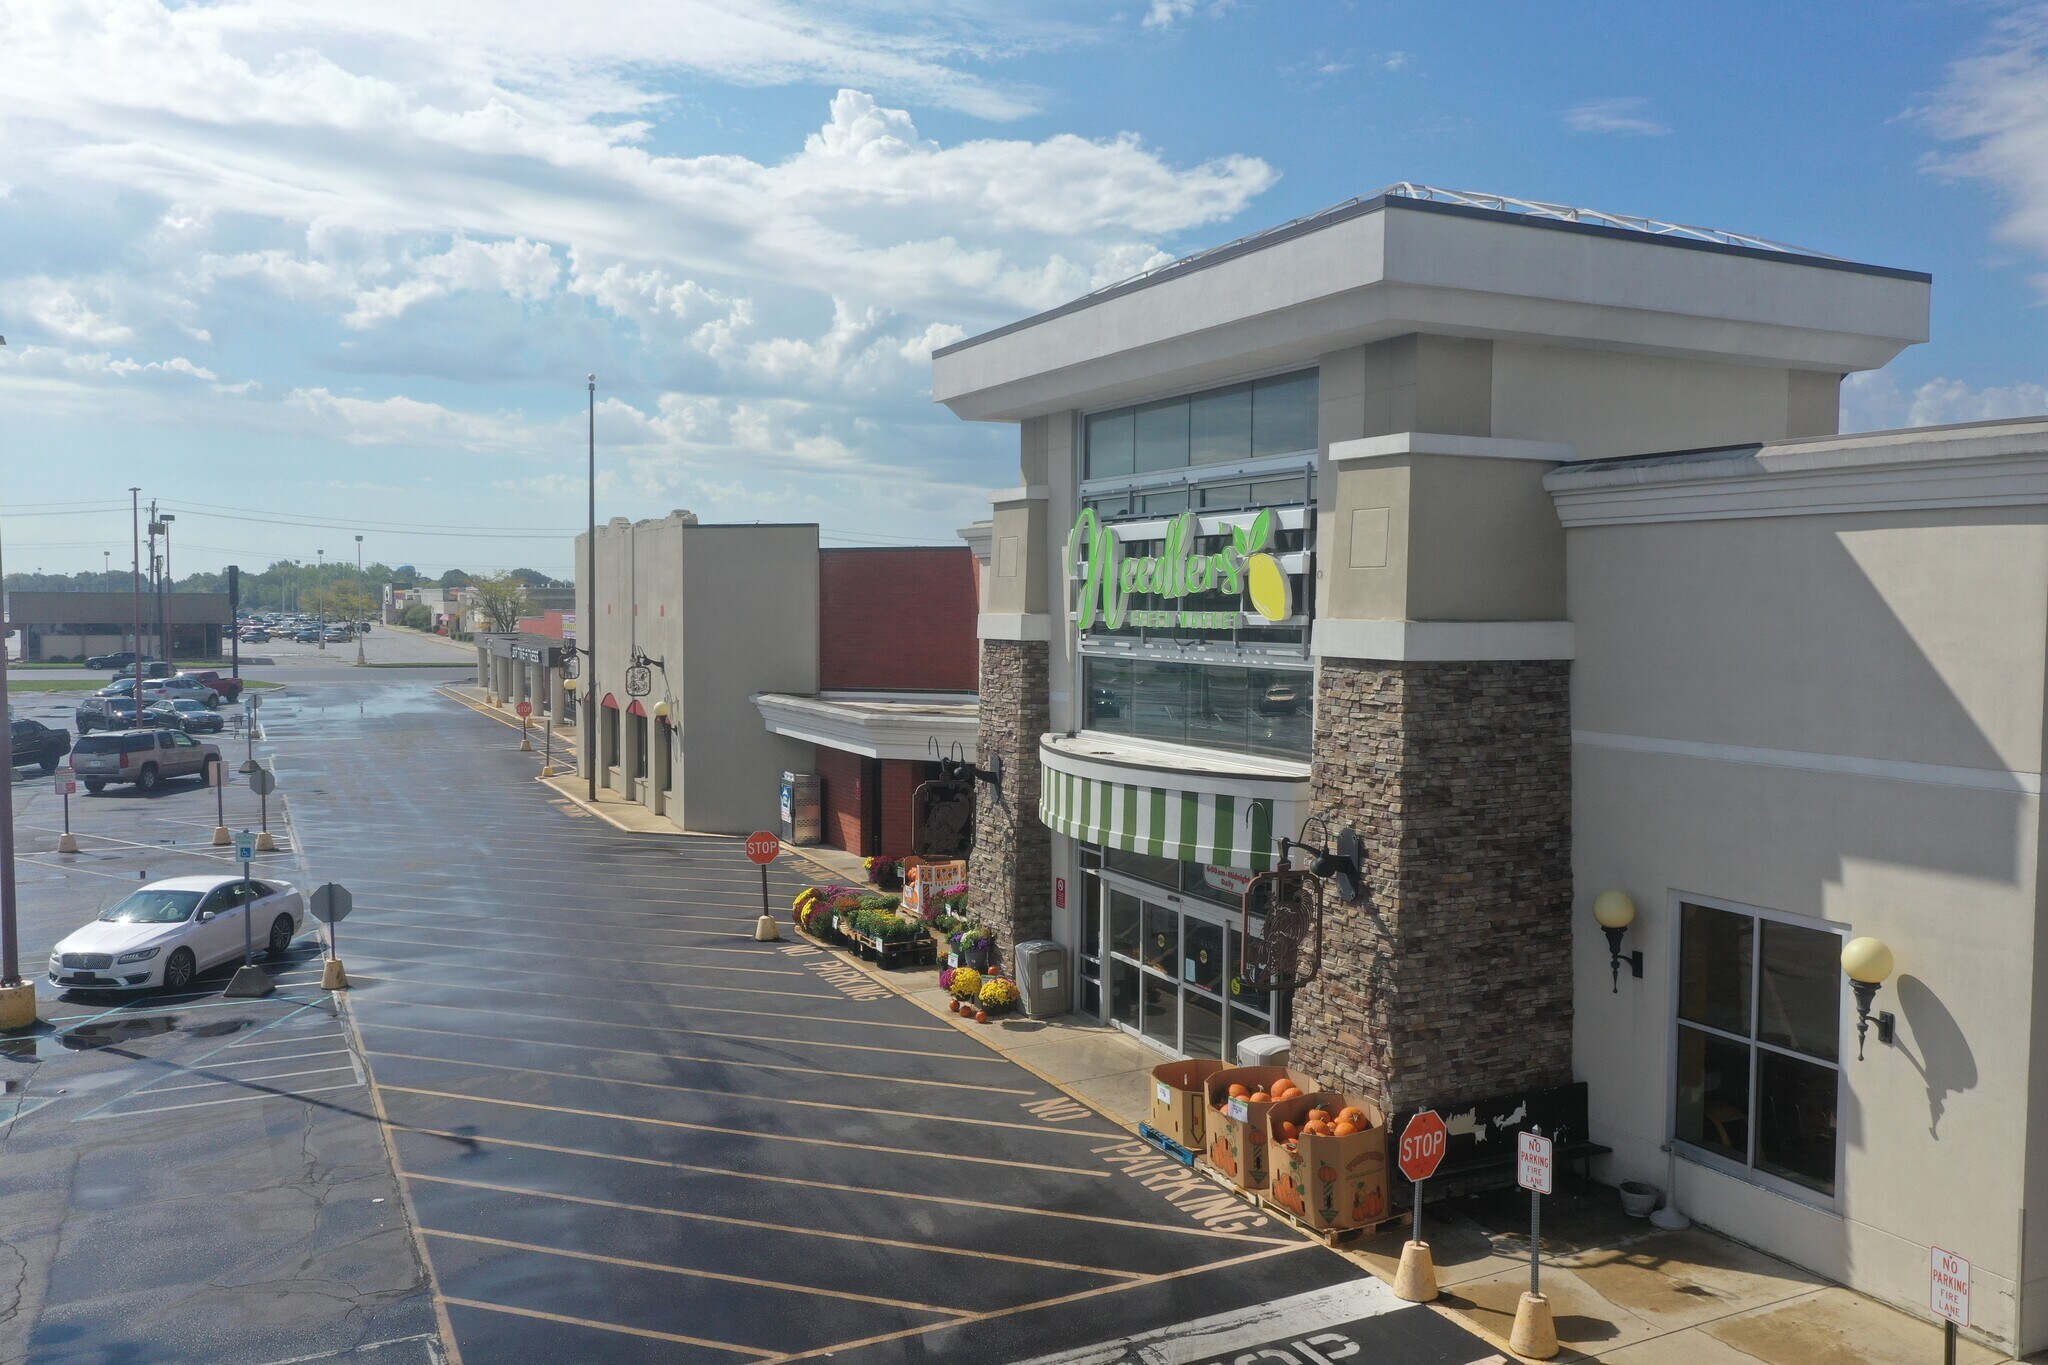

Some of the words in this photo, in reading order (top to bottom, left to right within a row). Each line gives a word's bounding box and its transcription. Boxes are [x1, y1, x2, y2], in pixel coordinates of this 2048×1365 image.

[1180, 611, 1243, 630] MARKET
[748, 841, 777, 855] STOP
[803, 960, 894, 1001] PARKING
[1019, 1096, 1092, 1122] NO
[1402, 1130, 1443, 1162] STOP
[1529, 1141, 1541, 1152] NO
[1521, 1152, 1549, 1168] PARKING
[1527, 1165, 1542, 1176] FIRE
[1090, 1140, 1269, 1233] PARKING
[1526, 1174, 1543, 1186] LANE
[1942, 1257, 1958, 1274] NO
[1933, 1269, 1967, 1295] PARKING
[1940, 1288, 1959, 1304] FIRE
[1938, 1300, 1960, 1318] LANE
